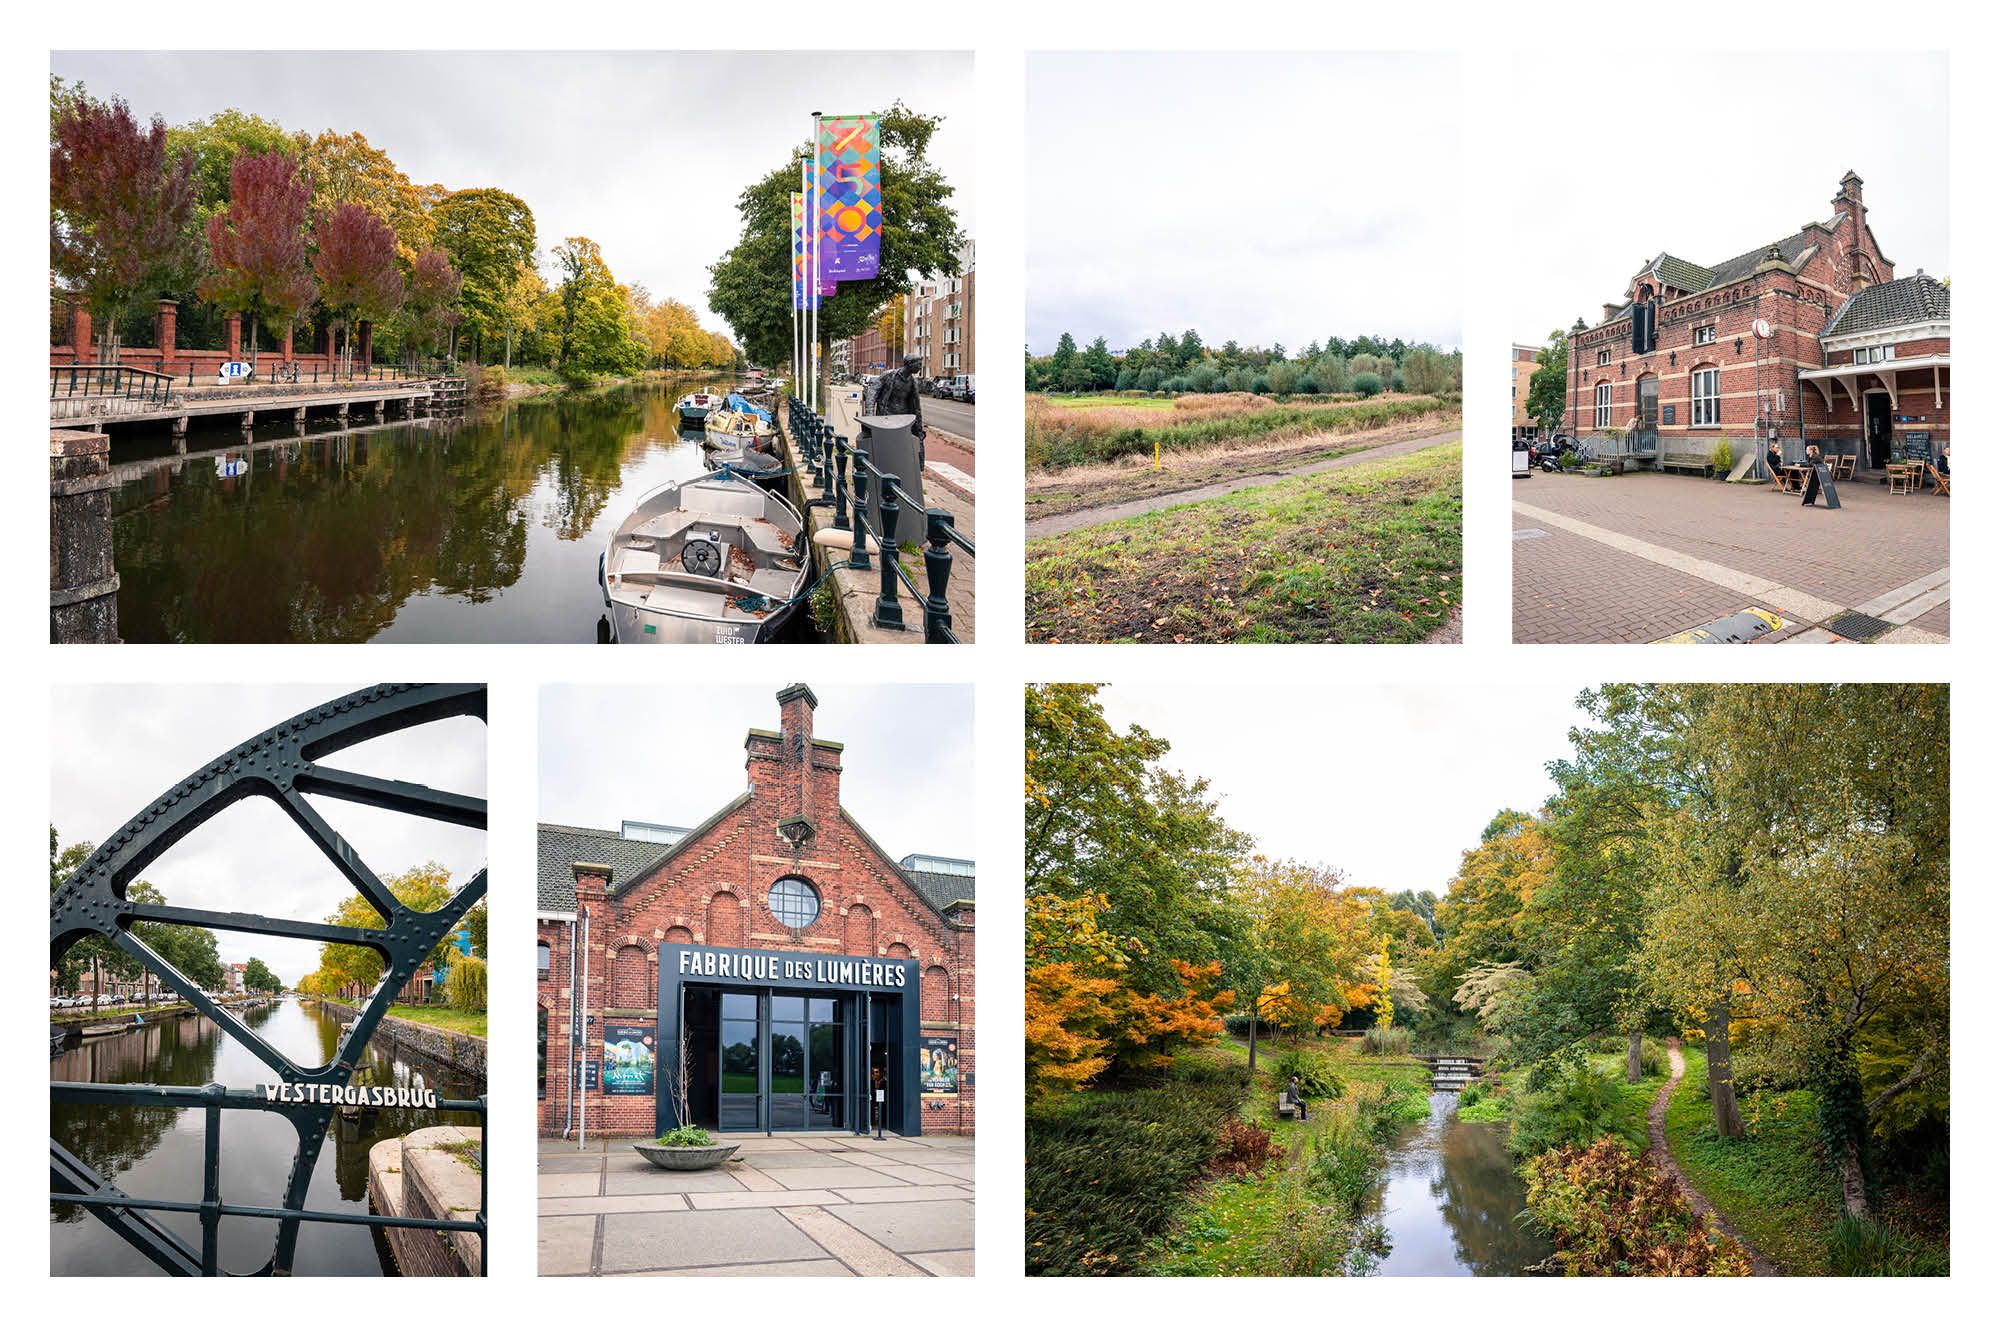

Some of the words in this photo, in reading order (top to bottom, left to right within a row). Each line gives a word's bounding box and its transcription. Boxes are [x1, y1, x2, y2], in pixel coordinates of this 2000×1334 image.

[716, 635, 744, 644] WESTER
[679, 950, 779, 980] FABRIQUE
[784, 960, 812, 980] DES
[816, 959, 906, 987] LUMIÈRES
[264, 1082, 437, 1108] WESTERGASBRUG
